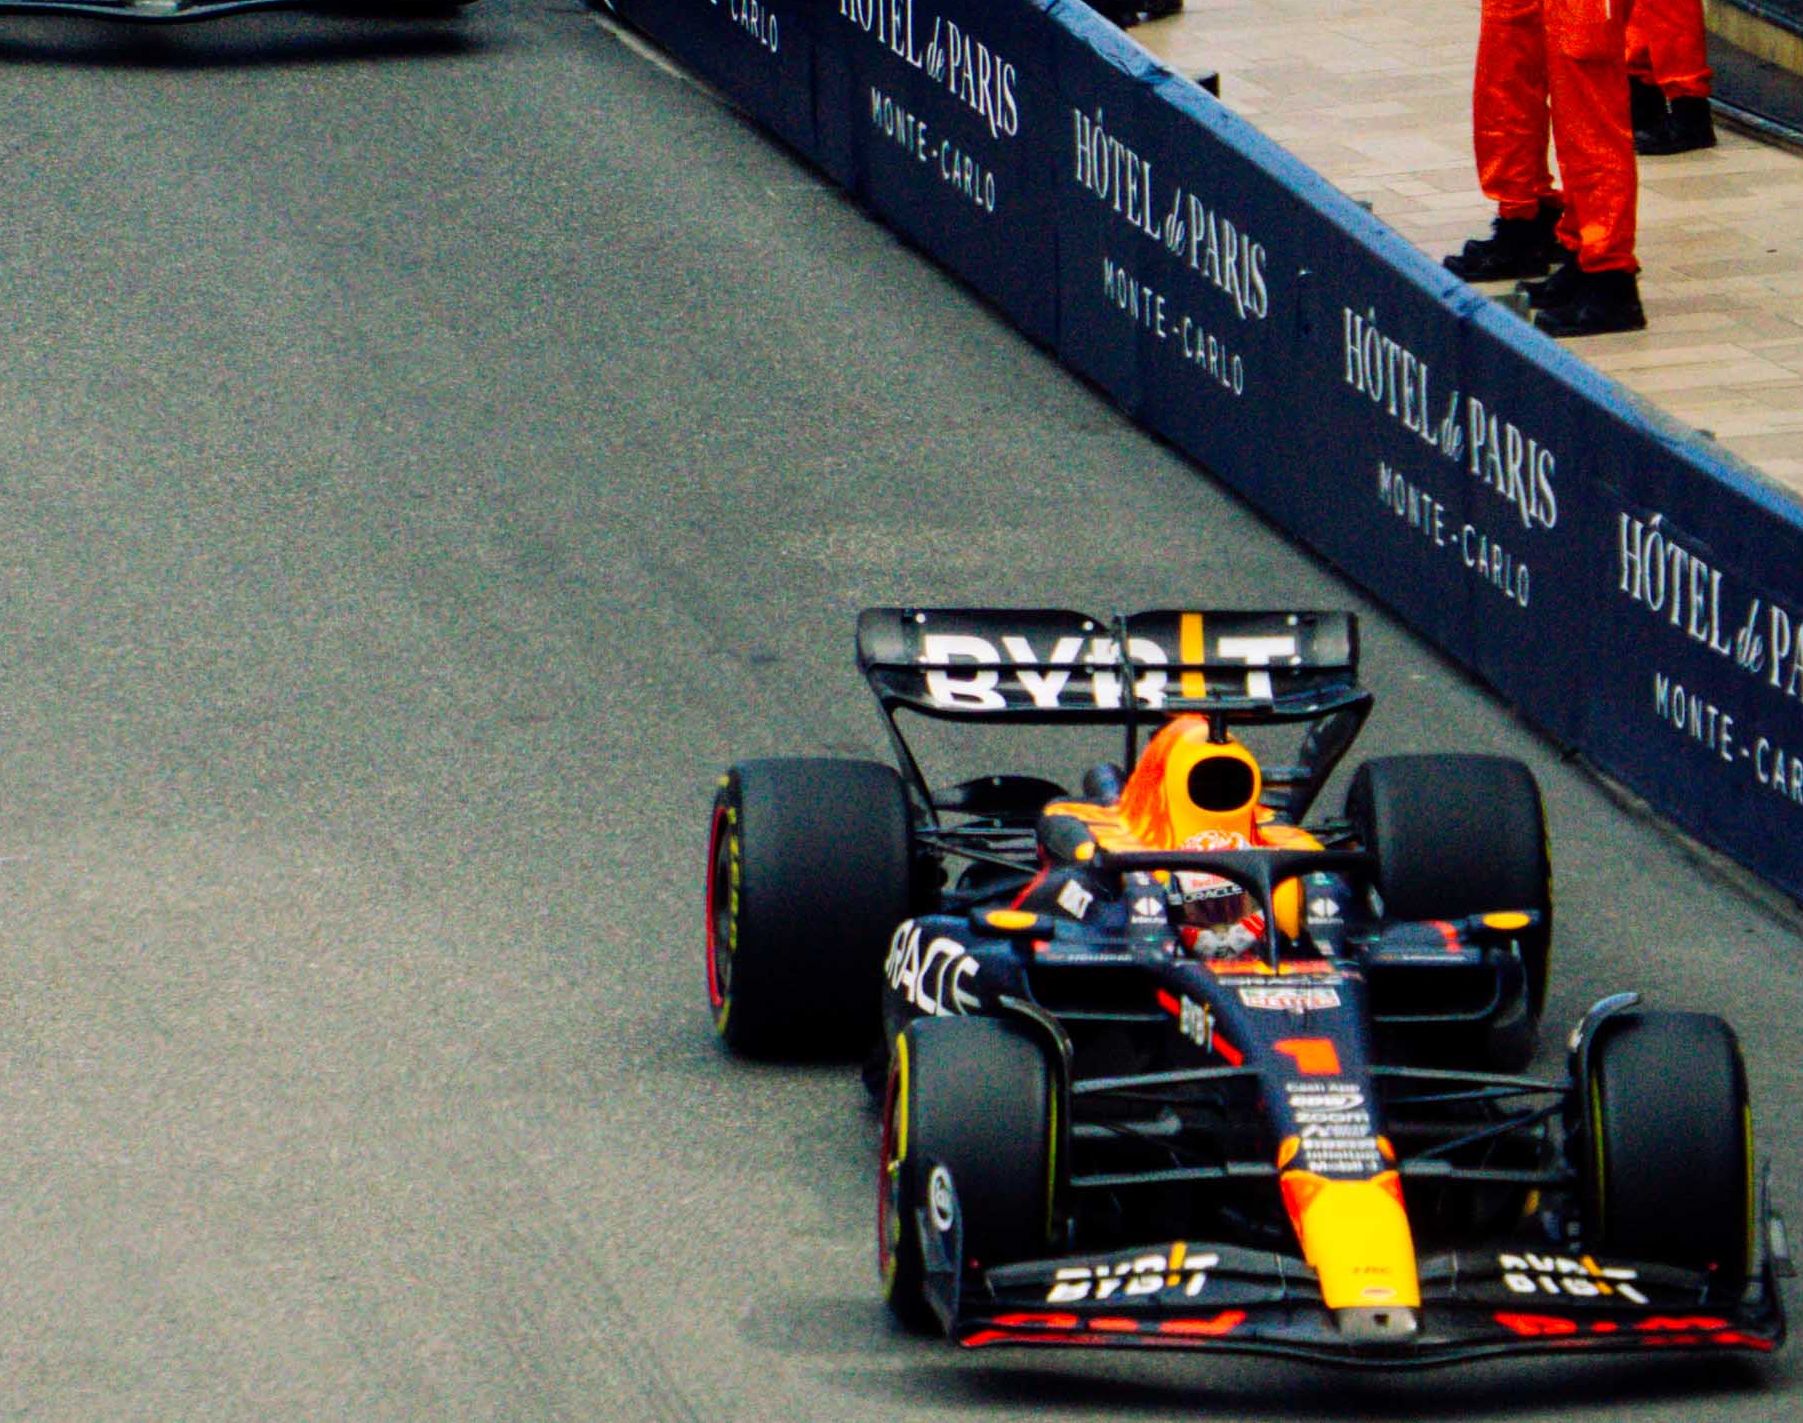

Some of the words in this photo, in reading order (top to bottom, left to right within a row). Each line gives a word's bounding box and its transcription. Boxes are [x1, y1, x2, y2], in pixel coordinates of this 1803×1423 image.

[925, 15, 946, 85] de
[947, 21, 1019, 140] PARIS
[870, 86, 996, 214] MONTE-CARLO
[1073, 106, 1162, 244] HÔTEL
[1165, 187, 1186, 258] de
[1187, 197, 1268, 321] PARIS
[1102, 258, 1245, 397] MONTE-CARLO
[1342, 305, 1439, 446] HÔTEL
[1439, 390, 1464, 462] de
[1468, 395, 1557, 530] PARIS
[1378, 462, 1531, 610] MONTE-CARLO
[1617, 511, 1733, 658] HÔTEL
[1735, 600, 1765, 674] de
[923, 613, 1297, 709] BYBIT
[884, 918, 982, 1017] RACLE
[1272, 1038, 1344, 1075] 1
[1045, 1240, 1219, 1303] BYBIT
